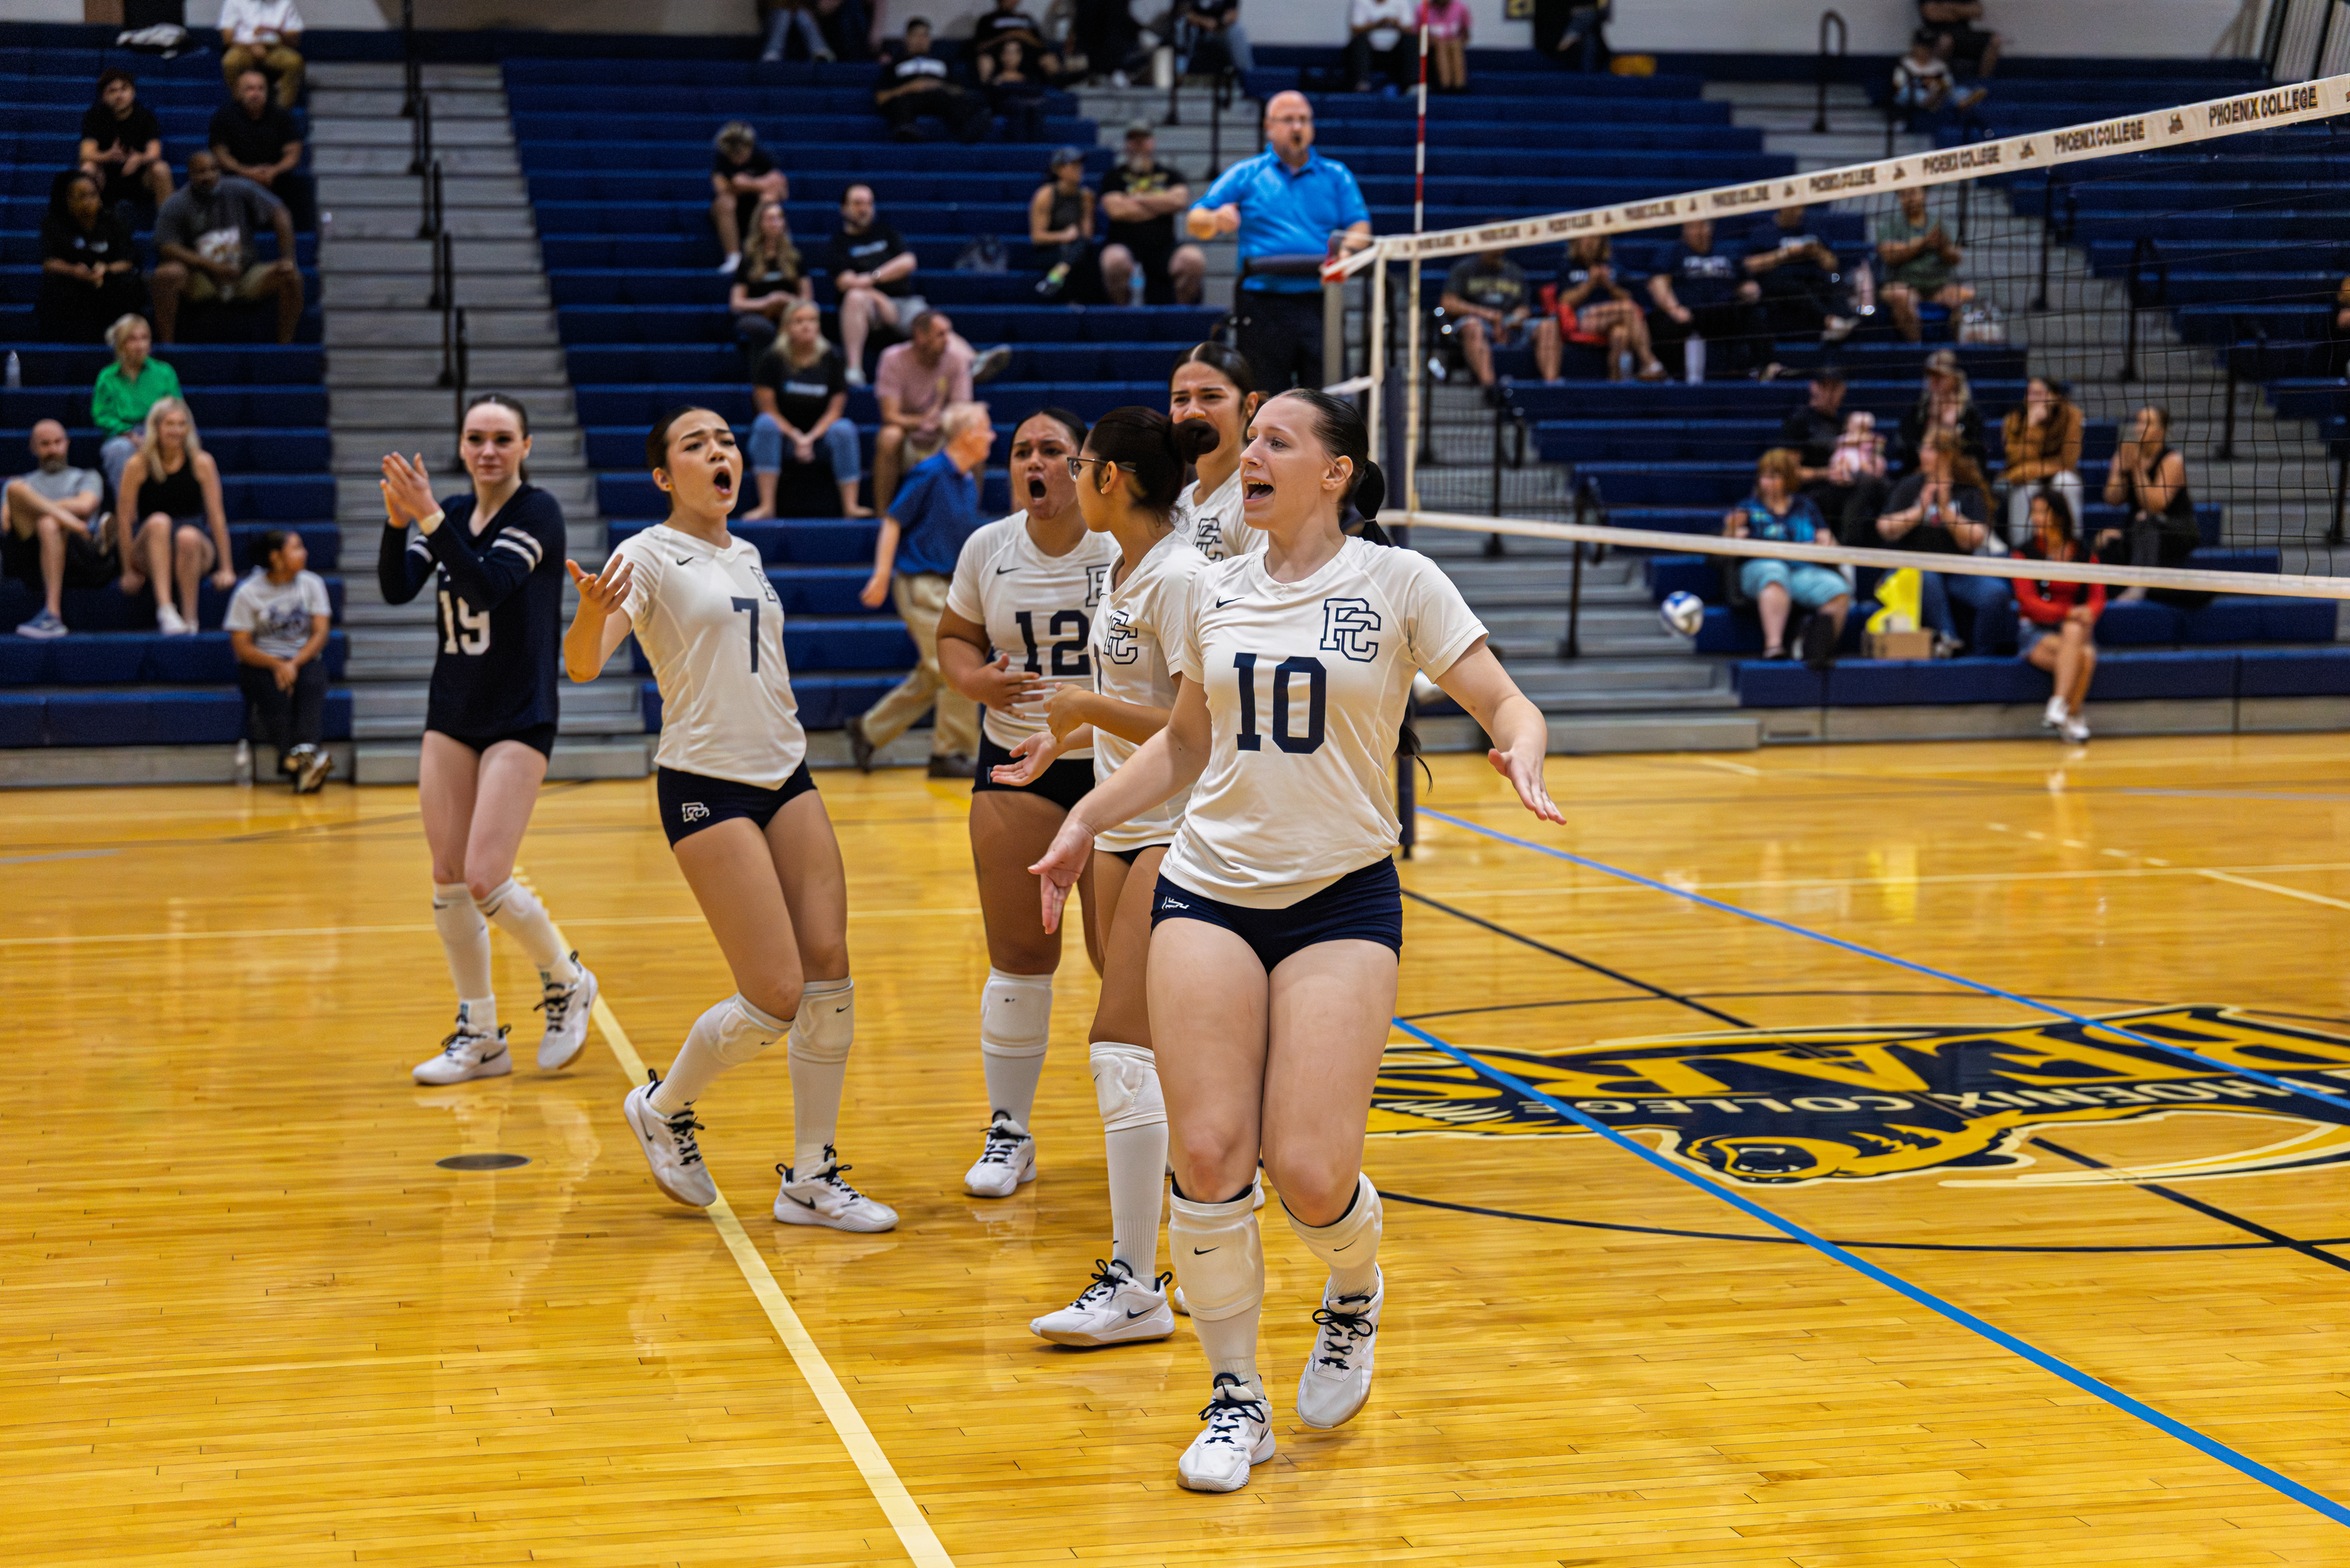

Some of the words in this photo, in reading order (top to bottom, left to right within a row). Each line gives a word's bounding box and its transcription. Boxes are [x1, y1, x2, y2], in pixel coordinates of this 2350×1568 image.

[2054, 127, 2097, 154] PHOENIX
[2097, 120, 2145, 144] COLLEGE
[2209, 96, 2261, 128] PHOENIX
[2261, 85, 2318, 118] COLLEGE
[439, 590, 490, 656] 19
[731, 596, 759, 674] 7
[1015, 610, 1092, 676] 12
[1320, 598, 1382, 663] PC
[1233, 652, 1327, 754] 10
[1373, 1010, 2350, 1098] BEARS
[1518, 1096, 1915, 1113] COLLEGE
[1928, 1077, 2347, 1110] PHOENIX
